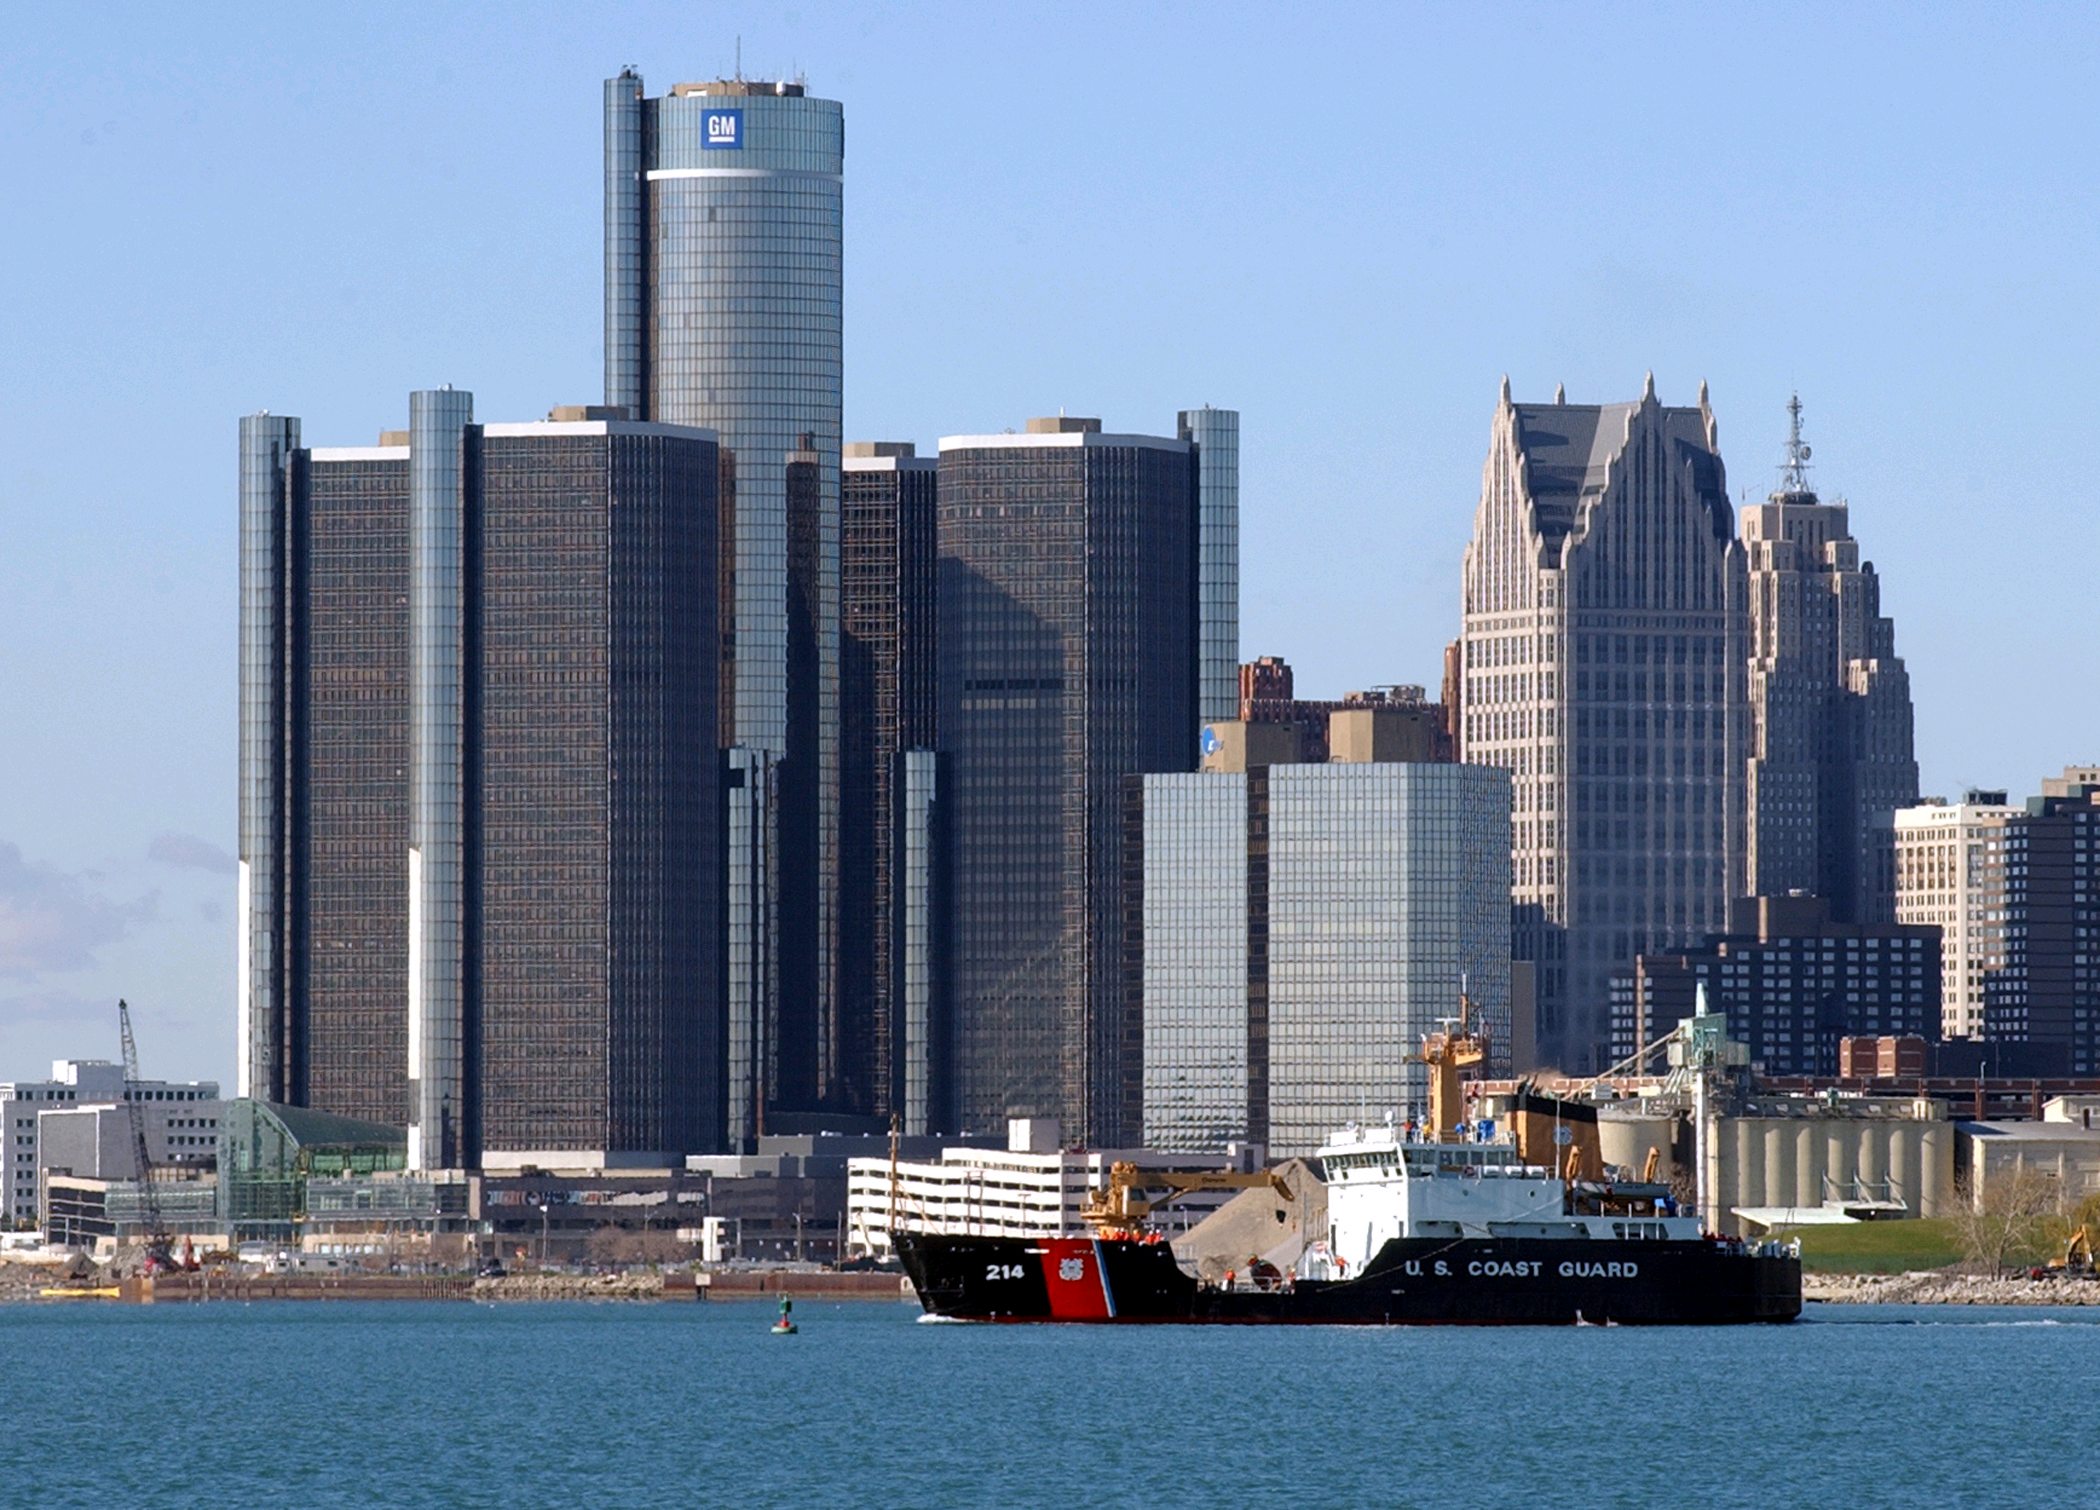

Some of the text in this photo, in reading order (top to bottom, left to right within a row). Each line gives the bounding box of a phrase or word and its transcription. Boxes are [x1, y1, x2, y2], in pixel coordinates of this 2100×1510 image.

[708, 115, 736, 136] GM
[986, 1264, 1025, 1280] 214
[1405, 1260, 1638, 1278] U. S. COAST GUARD
